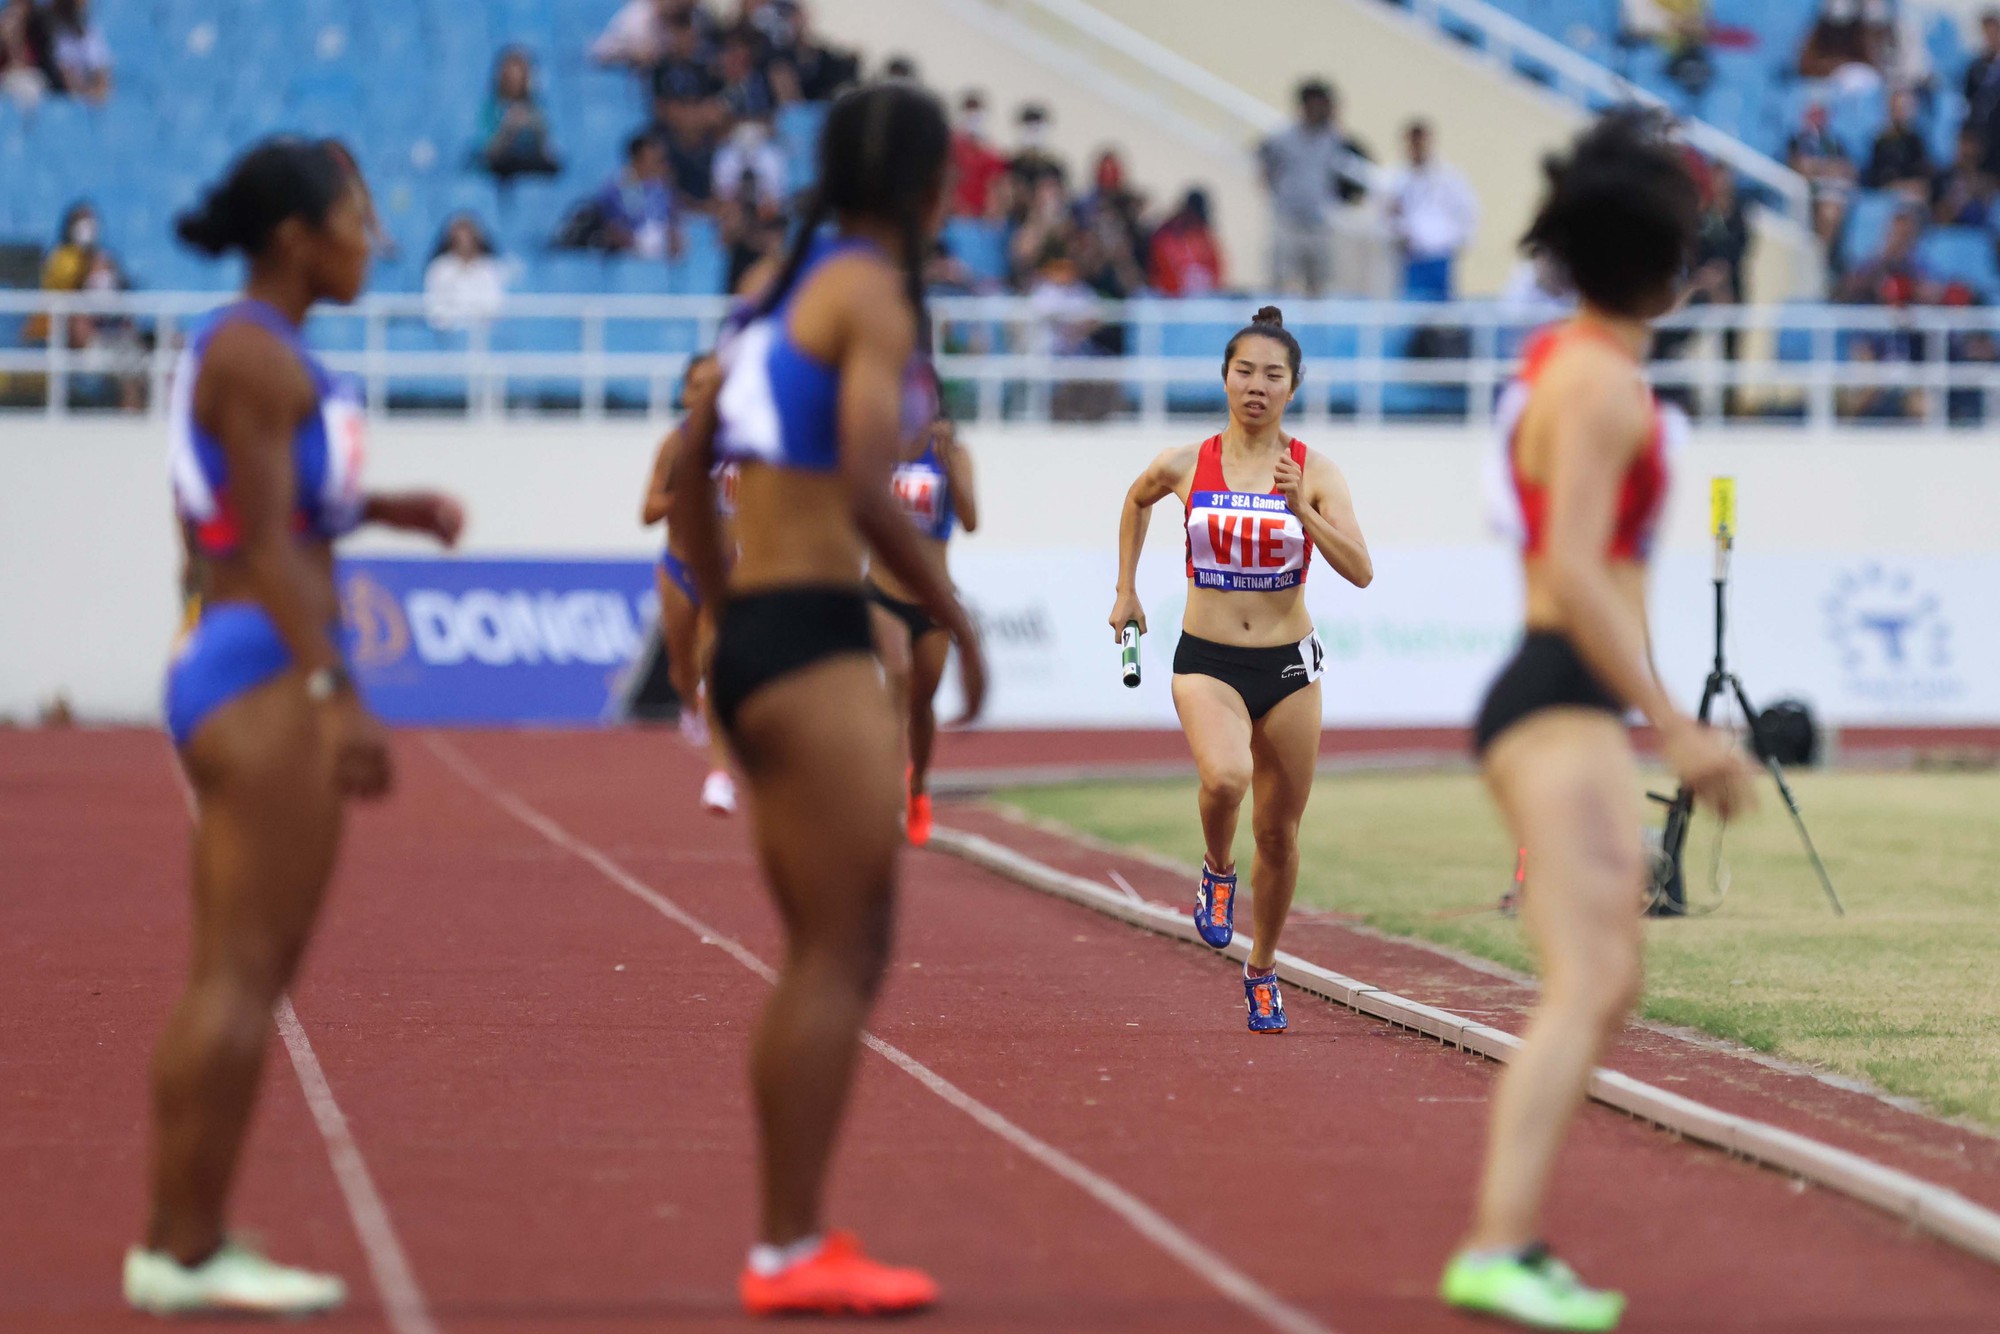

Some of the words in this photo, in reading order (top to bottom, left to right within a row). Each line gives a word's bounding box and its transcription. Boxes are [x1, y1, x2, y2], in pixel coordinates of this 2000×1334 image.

[1231, 495, 1250, 508] SEA
[1252, 496, 1286, 511] Games
[1207, 513, 1286, 568] VIE
[1200, 571, 1225, 587] HANOI
[1233, 575, 1273, 589] VIETNAM
[1274, 572, 1294, 588] 2022
